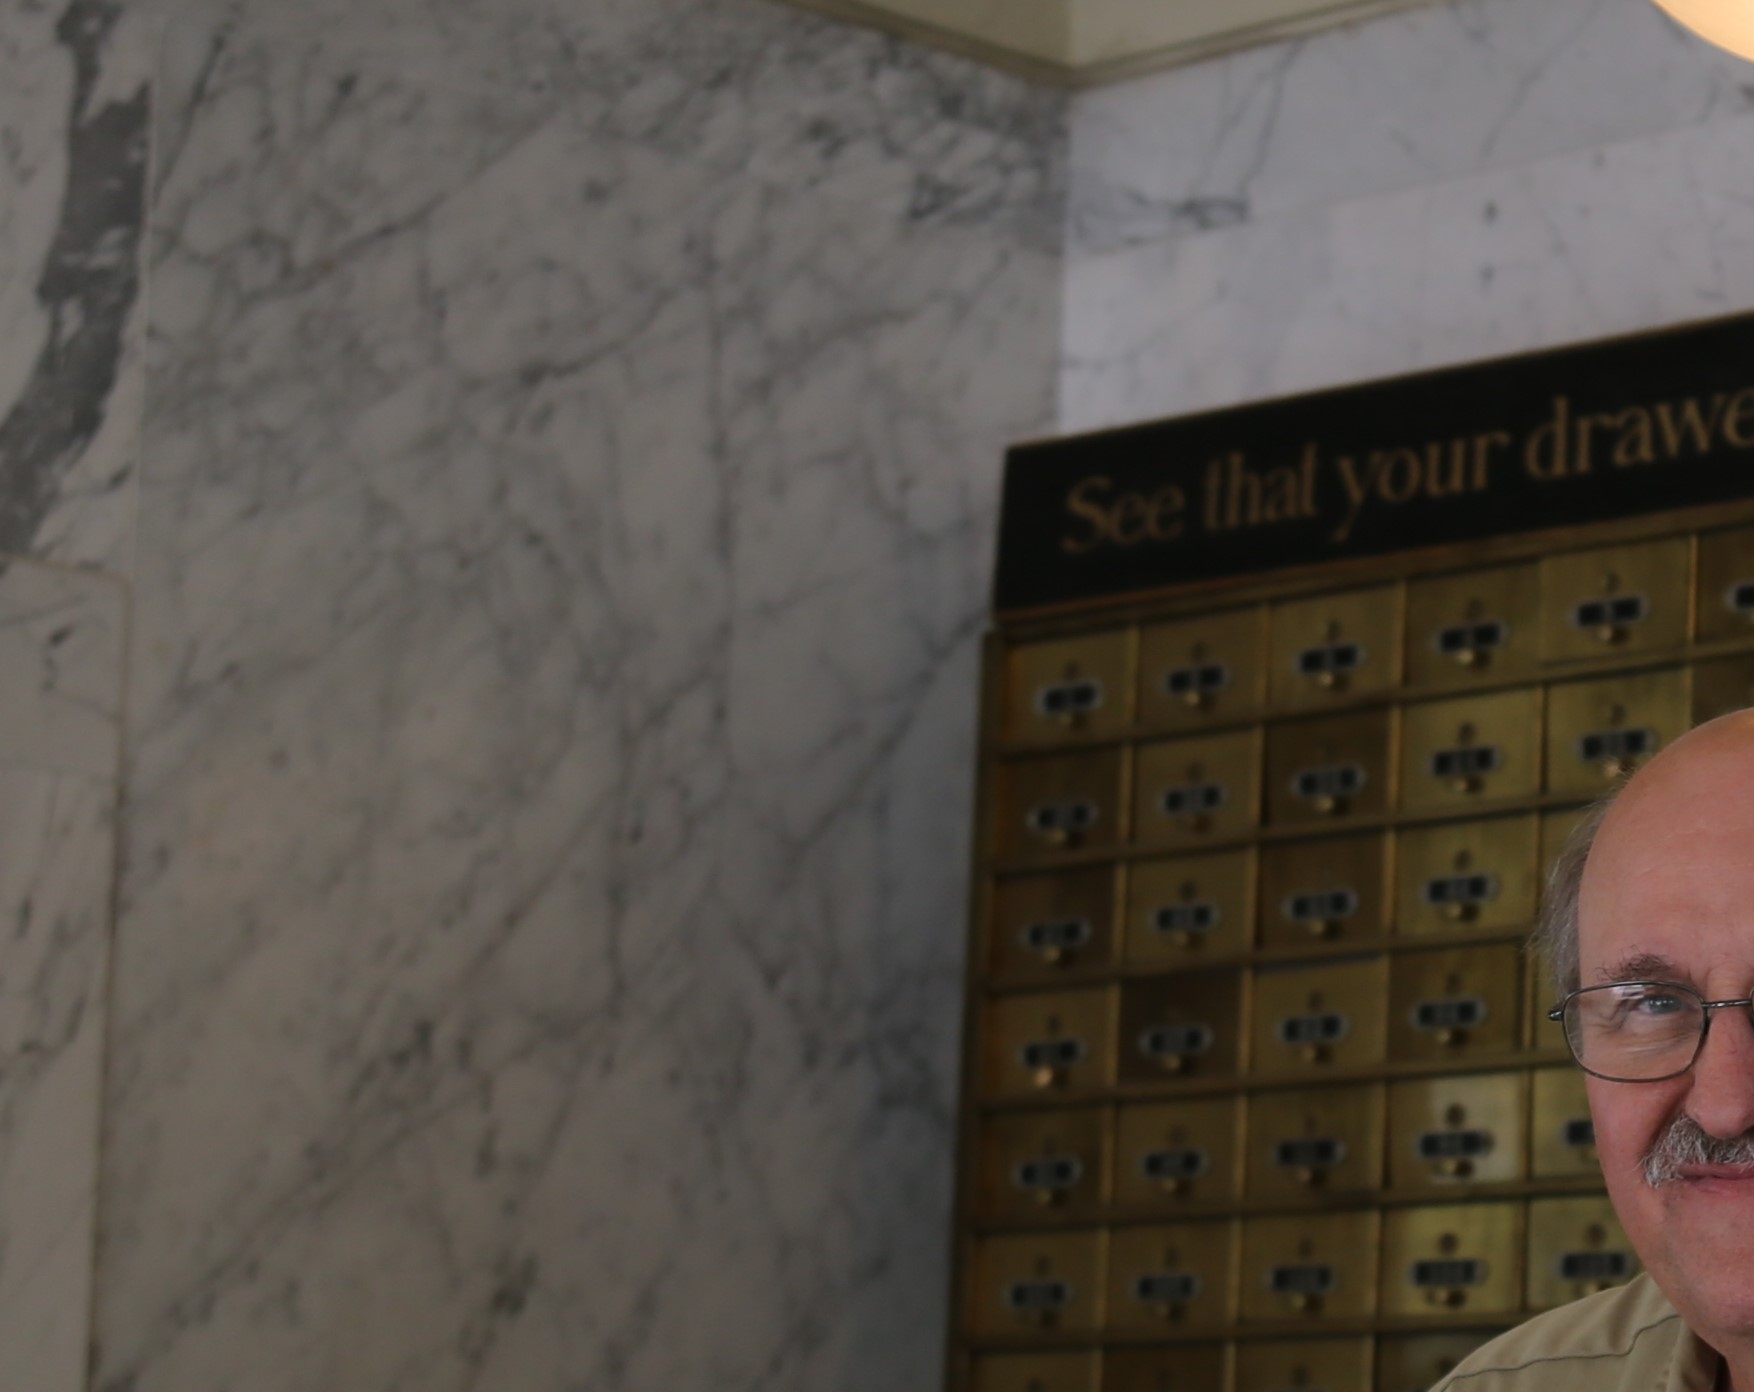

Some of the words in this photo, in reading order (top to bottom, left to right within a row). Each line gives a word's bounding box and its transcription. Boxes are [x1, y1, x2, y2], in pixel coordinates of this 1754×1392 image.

[1061, 473, 1185, 553] See
[1204, 440, 1318, 531] that
[1331, 431, 1510, 543] your
